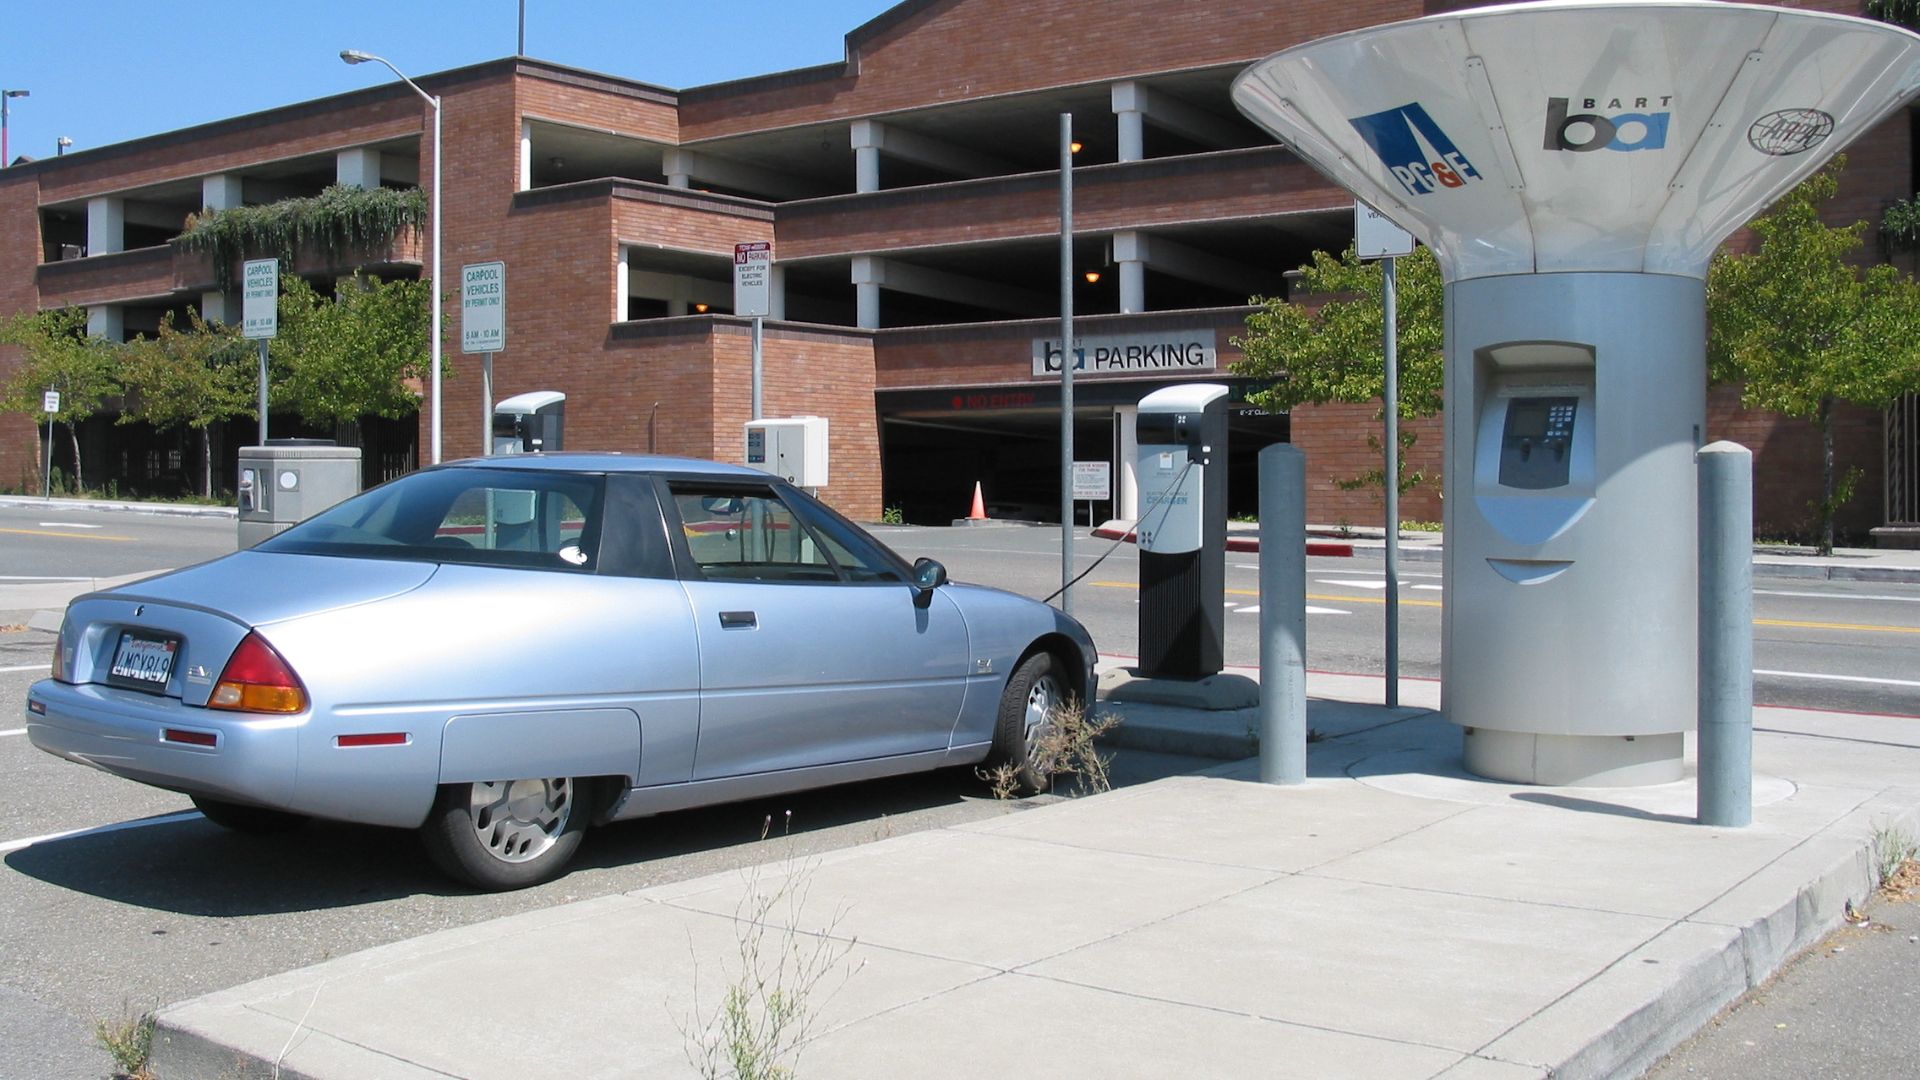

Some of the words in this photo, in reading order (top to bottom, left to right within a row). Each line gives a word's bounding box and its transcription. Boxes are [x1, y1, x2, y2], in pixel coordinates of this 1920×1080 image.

[1582, 96, 1673, 109] BART
[1391, 151, 1480, 196] PG&E
[736, 252, 746, 263] NO
[748, 251, 769, 260] PARKING
[247, 265, 273, 276] CARPOOL
[466, 269, 499, 282] CARPOOL
[247, 277, 273, 288] VEHICLES
[466, 283, 499, 296] VEHICLES
[465, 300, 471, 308] BY
[471, 298, 487, 307] PERMIT
[488, 297, 500, 306] ONLY
[471, 331, 479, 339] AM
[483, 330, 489, 338] 10
[490, 329, 499, 338] AM
[1095, 343, 1204, 370] PARKING
[968, 394, 986, 408] NO
[991, 392, 1035, 407] ENTRY
